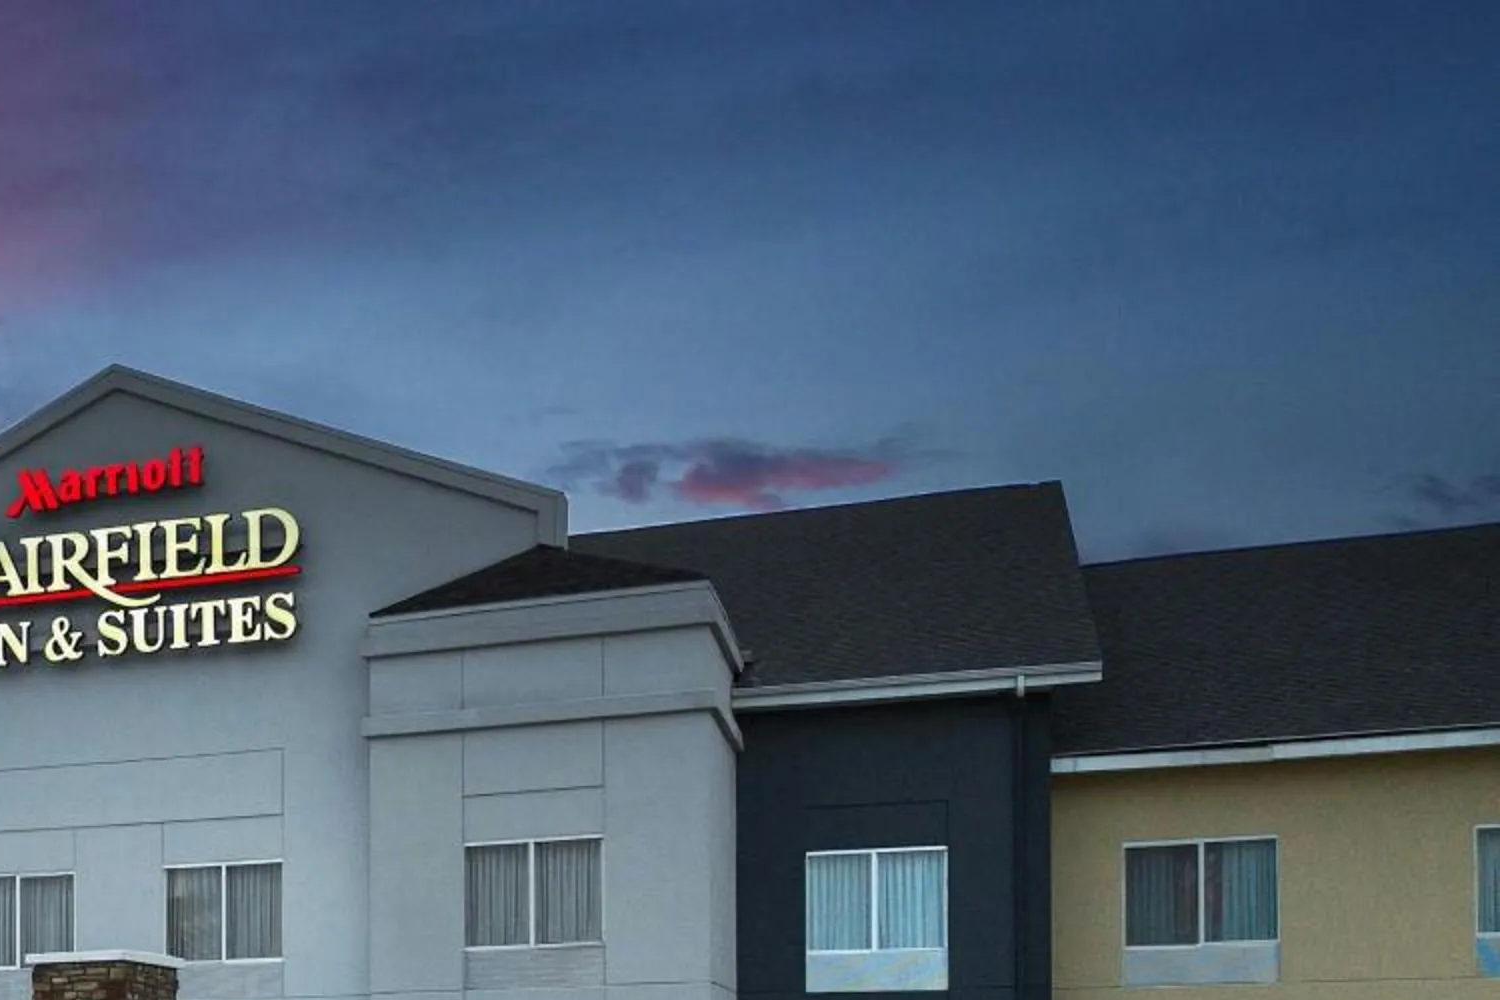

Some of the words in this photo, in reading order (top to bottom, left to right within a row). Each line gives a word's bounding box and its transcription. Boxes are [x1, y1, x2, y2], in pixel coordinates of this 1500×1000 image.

[5, 444, 204, 518] Marriott
[44, 615, 83, 663] &
[97, 592, 297, 658] SUITES
